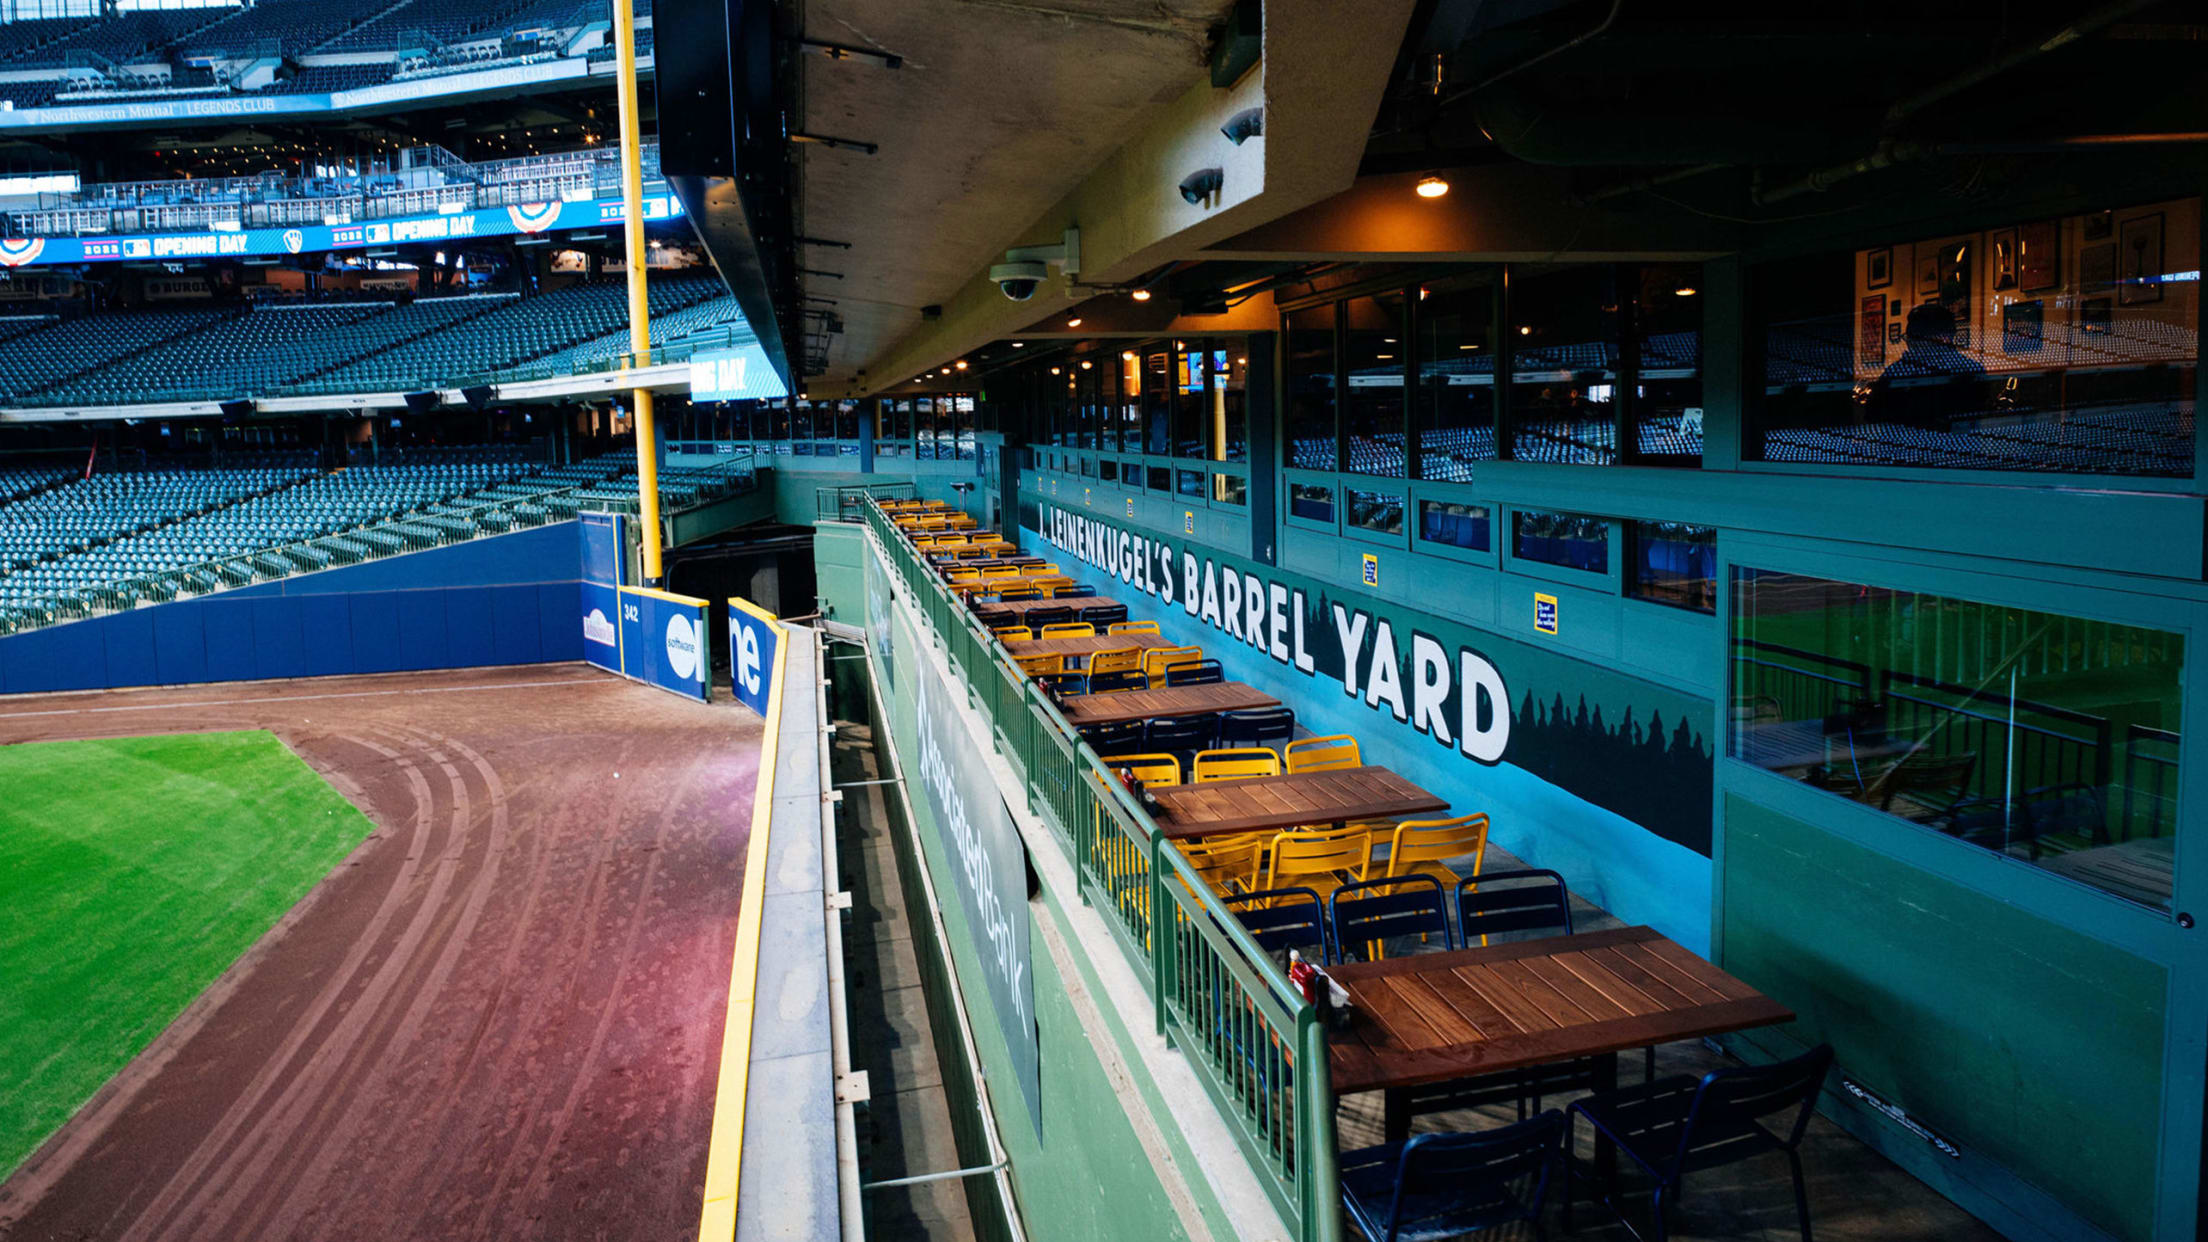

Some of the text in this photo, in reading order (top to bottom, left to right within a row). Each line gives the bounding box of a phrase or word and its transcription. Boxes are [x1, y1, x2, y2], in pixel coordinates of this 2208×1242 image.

[40, 97, 275, 124] Northwestern Mutual LEGENDS CLUB
[392, 215, 475, 242] OPENING DAY
[153, 234, 248, 256] OPENING DAY
[718, 356, 747, 391] DAY
[624, 603, 639, 622] 342
[1039, 501, 1510, 762] J. LEINENKUGEL'S BARREL YARD
[668, 637, 695, 654] software
